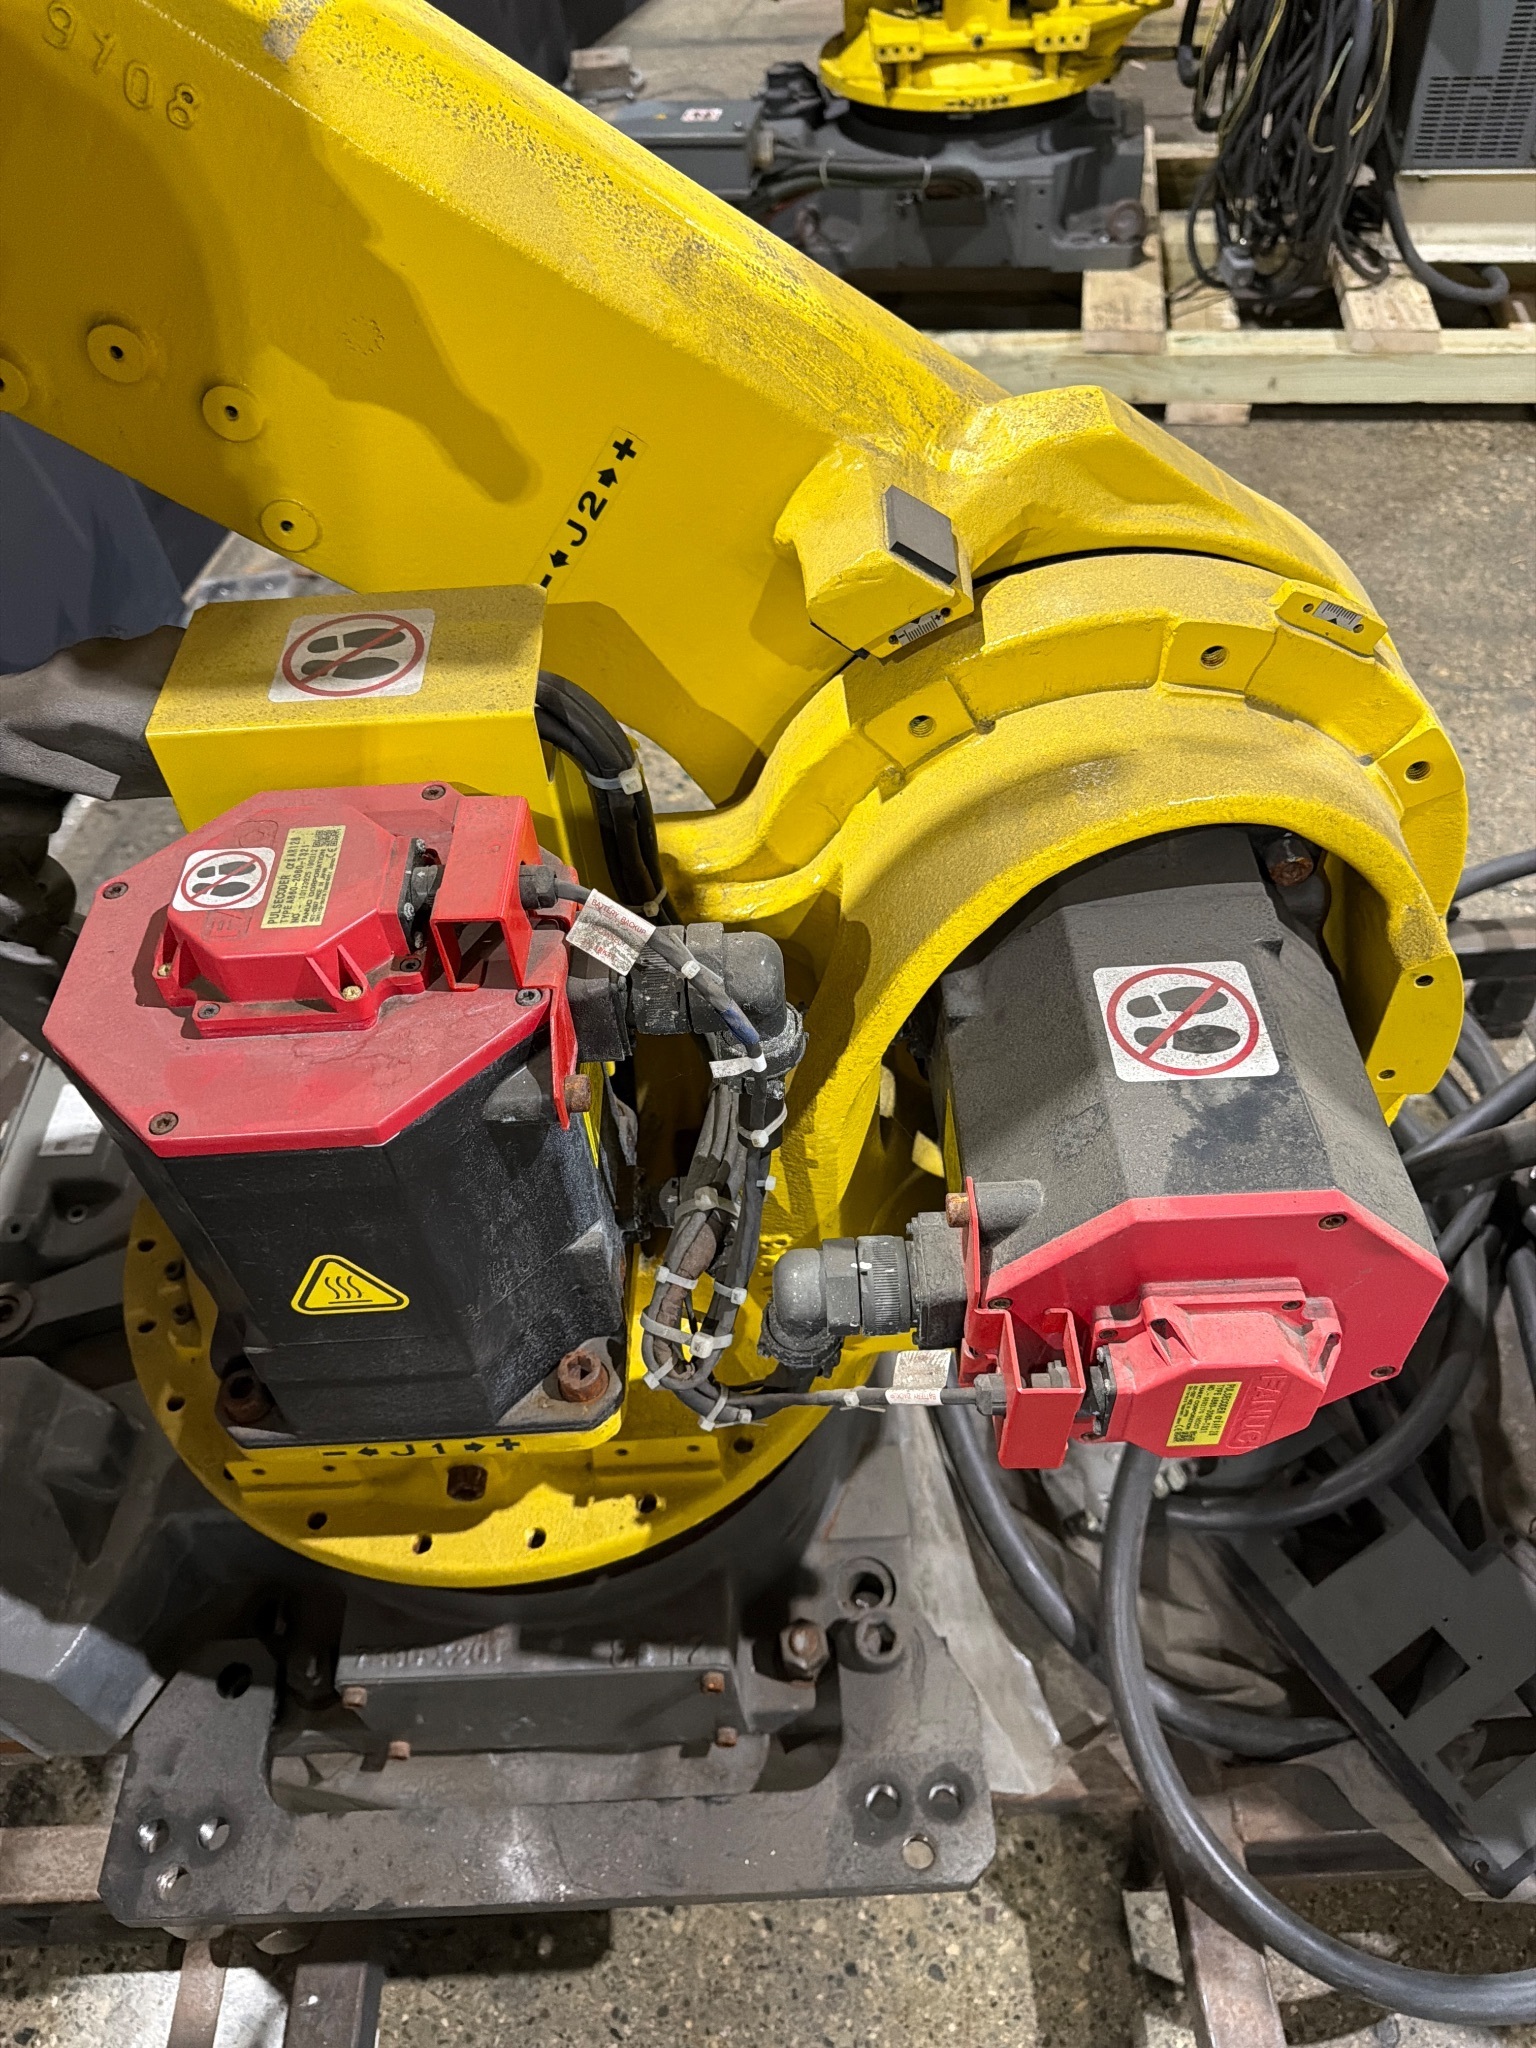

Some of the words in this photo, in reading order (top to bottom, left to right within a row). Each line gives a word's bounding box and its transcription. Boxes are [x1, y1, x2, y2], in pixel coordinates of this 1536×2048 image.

[566, 490, 608, 547] J2
[267, 874, 290, 923] PULSECODER
[301, 899, 312, 922] FANUC
[308, 848, 325, 896] CORPORATION
[280, 905, 292, 923] TYPE
[591, 898, 619, 919] BATTERY
[620, 916, 646, 935] BACKUP
[1237, 1373, 1288, 1444] FANUC
[390, 1443, 446, 1456] J1
